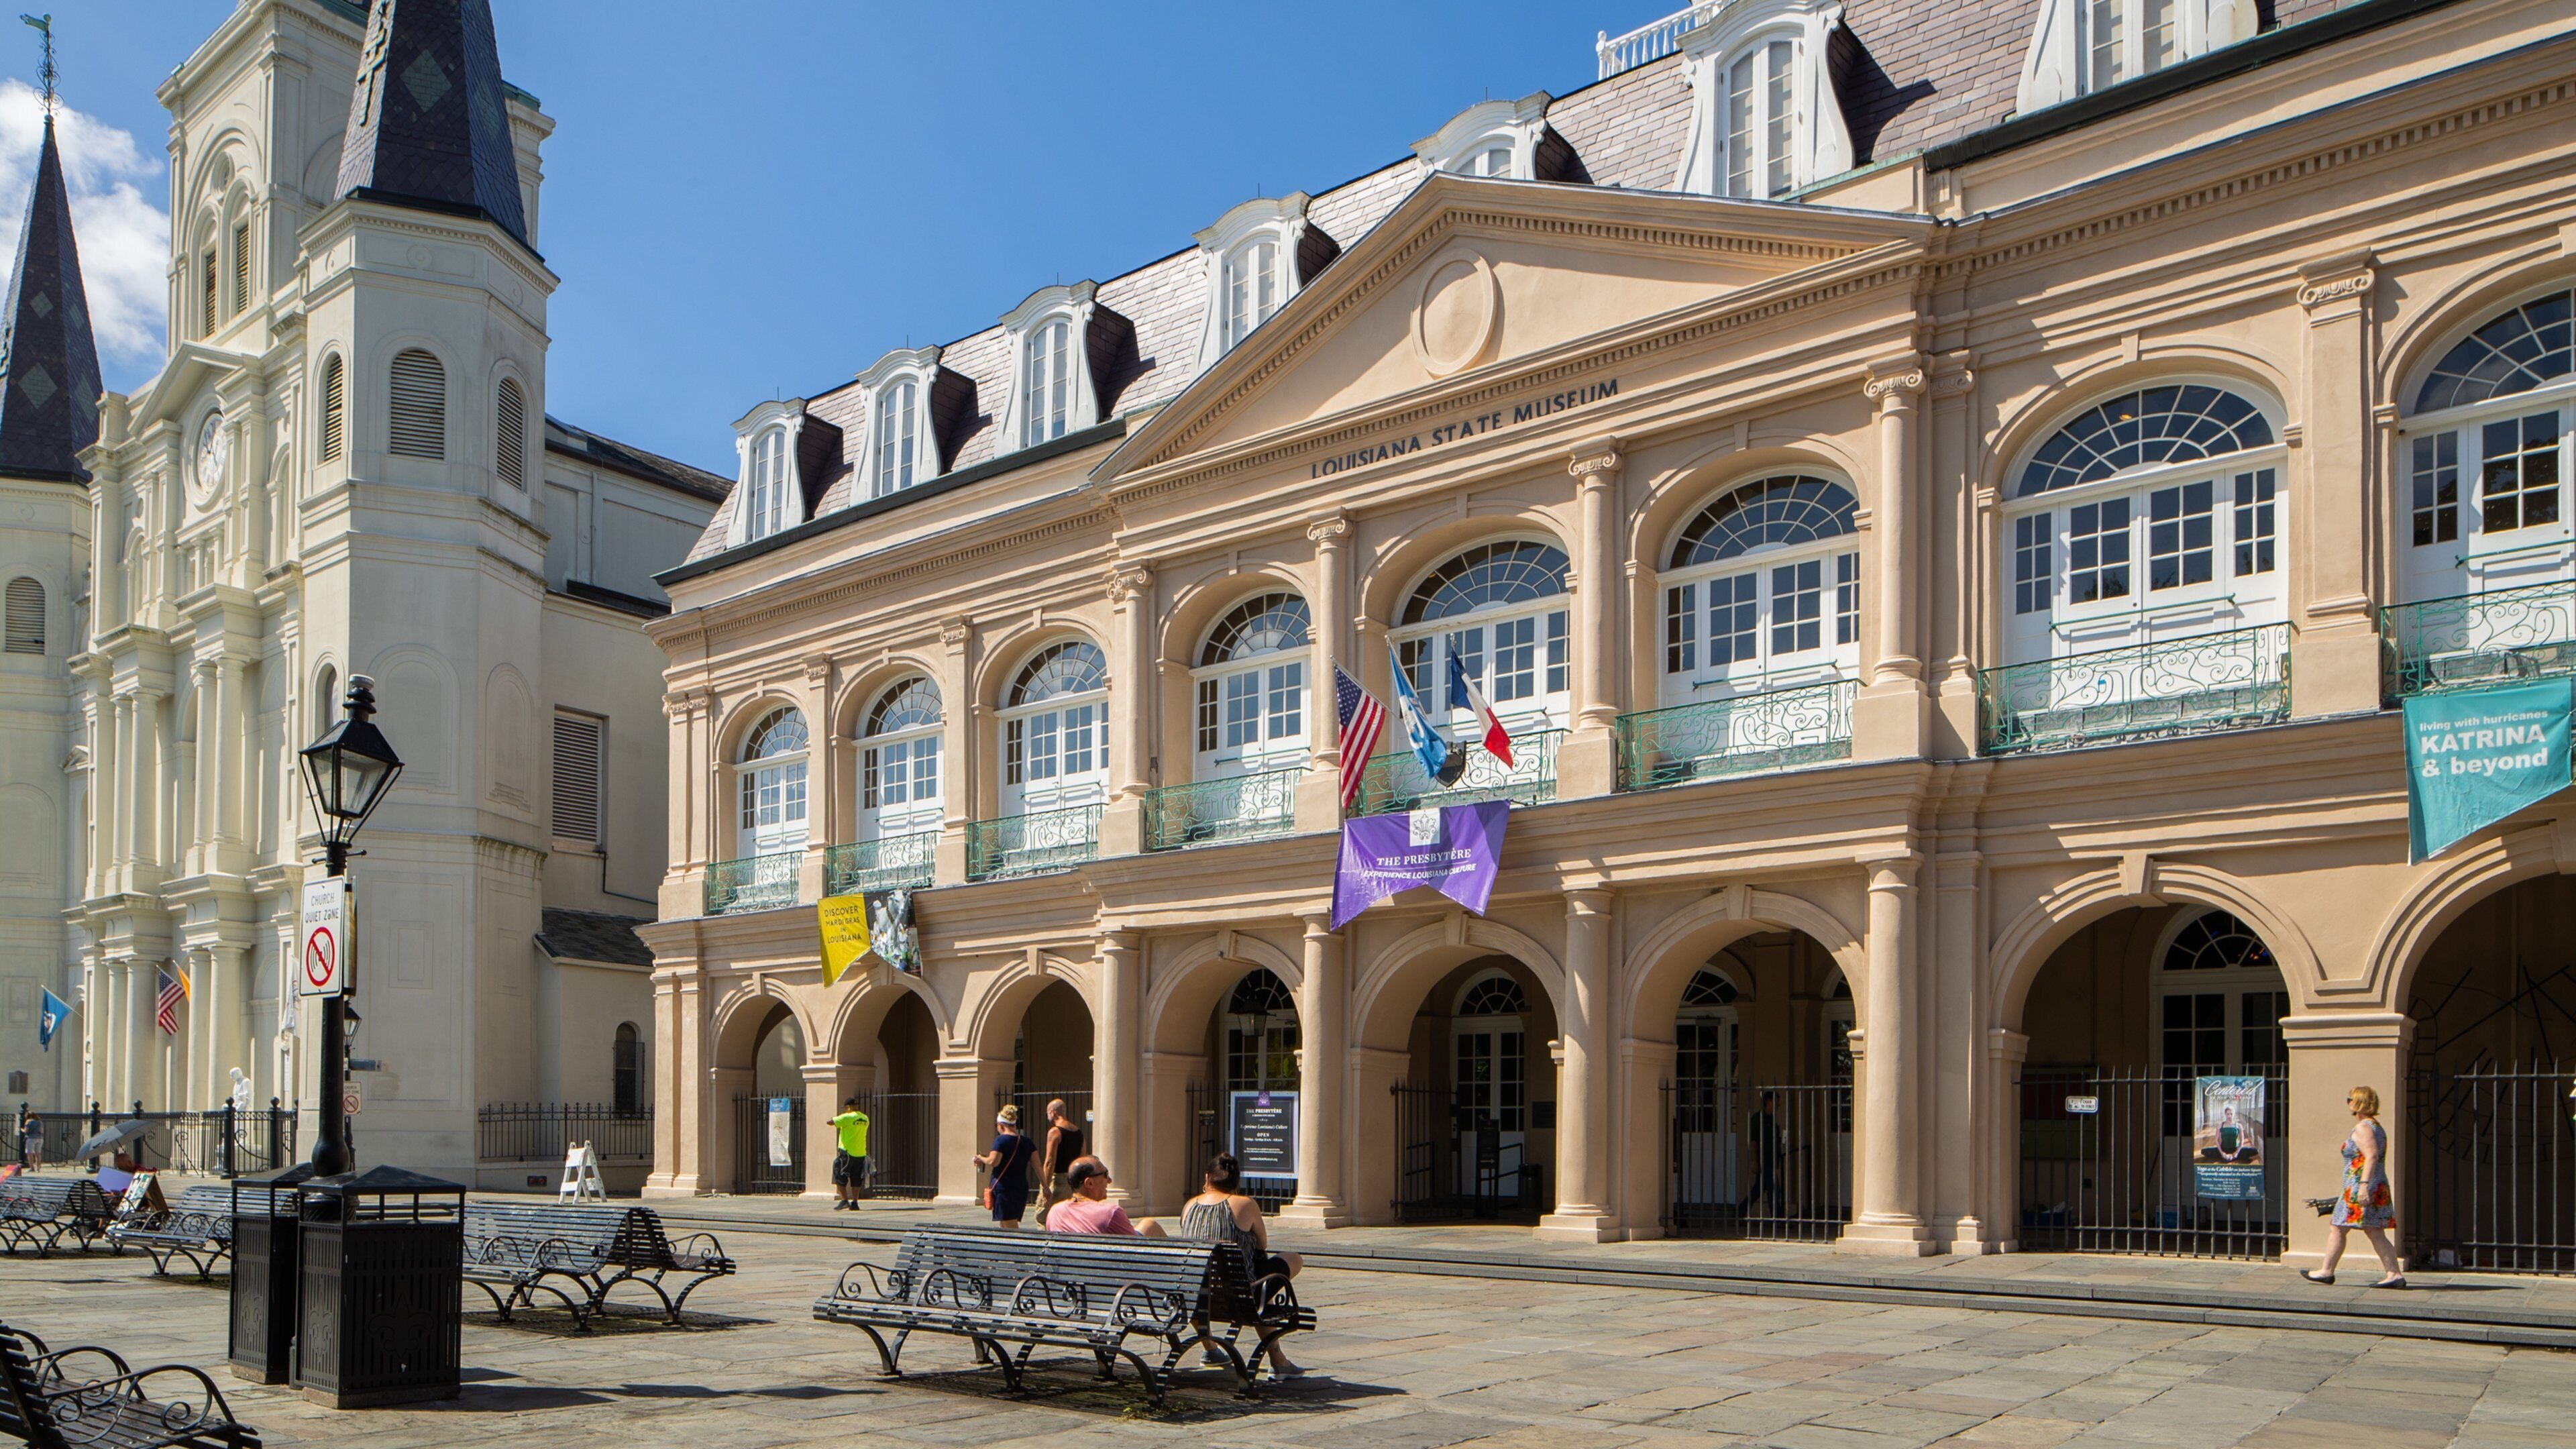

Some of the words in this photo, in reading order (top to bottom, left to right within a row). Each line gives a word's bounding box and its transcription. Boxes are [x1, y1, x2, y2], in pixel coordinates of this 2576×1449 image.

[1311, 435, 1421, 479] LOUISIANA
[1432, 412, 1503, 446] STATE
[1514, 379, 1619, 424] MUSEUM
[2420, 721, 2450, 731] living
[2454, 717, 2479, 728] with
[2483, 711, 2548, 724] hurricanes
[2421, 724, 2546, 754] KATRINA
[2422, 759, 2440, 777] &
[2451, 747, 2548, 777] beyond
[1377, 856, 1401, 865] THE
[1404, 848, 1471, 865] PRESBYTÈRE
[1363, 870, 1411, 879] EXPERIENCE
[1412, 869, 1448, 879] LOUISIANA
[1449, 864, 1476, 875] CULTURE
[311, 892, 335, 906] CHURCH
[305, 910, 321, 923] QUIET
[323, 908, 339, 920] ZONE
[824, 906, 859, 917] DISCOVER
[826, 917, 844, 926] MARDI
[845, 916, 860, 924] GRAS
[827, 933, 862, 944] LOUISIANA
[2205, 1080, 2263, 1095] Centered
